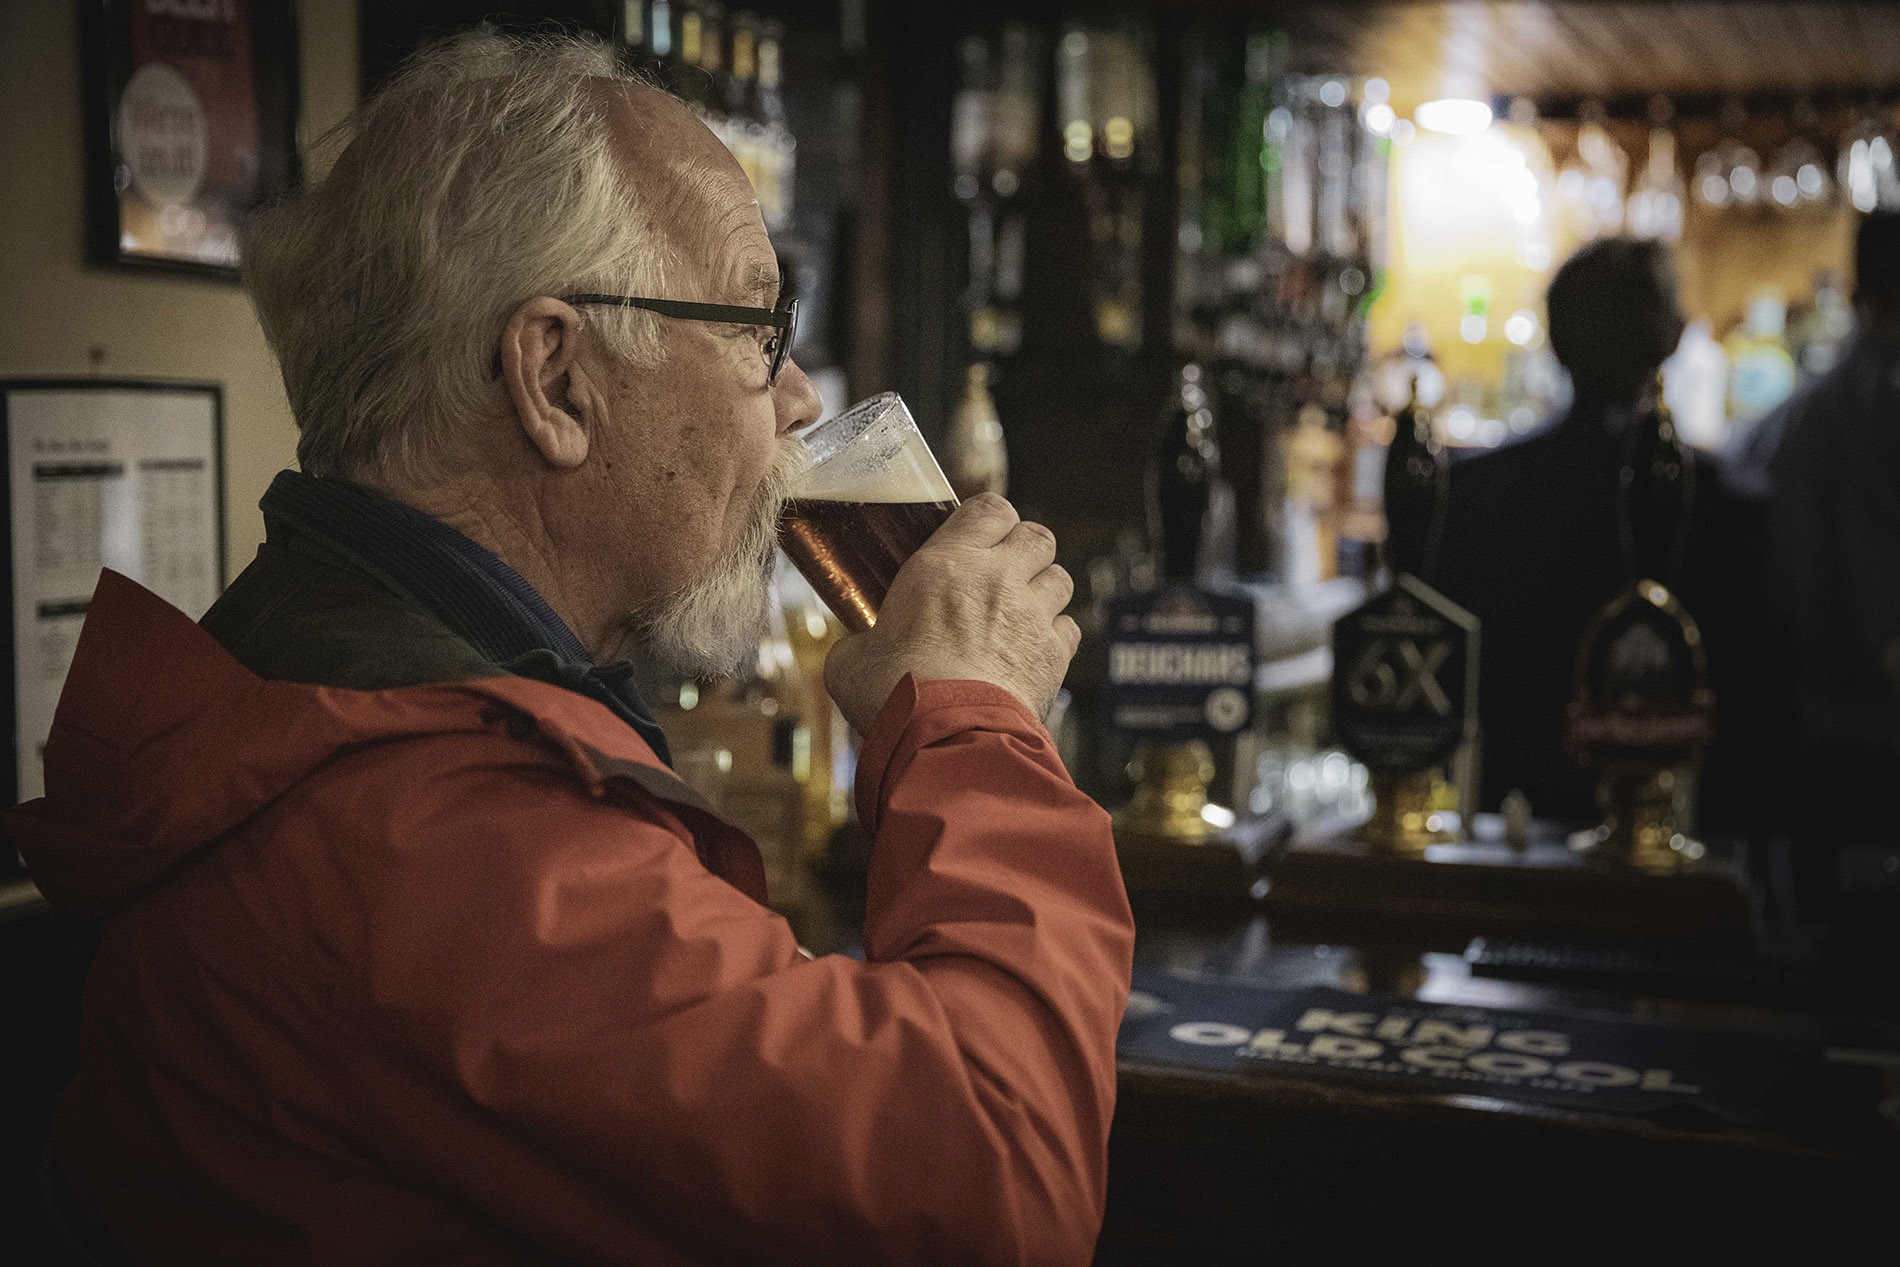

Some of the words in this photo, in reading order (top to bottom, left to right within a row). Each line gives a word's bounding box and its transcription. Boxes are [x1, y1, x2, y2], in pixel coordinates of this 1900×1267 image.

[1110, 642, 1251, 685] DEUCHARS
[1350, 639, 1452, 717] 6X
[1169, 1021, 1384, 1059] OLD
[1402, 1045, 1700, 1095] COOL
[1297, 1007, 1570, 1056] KING
